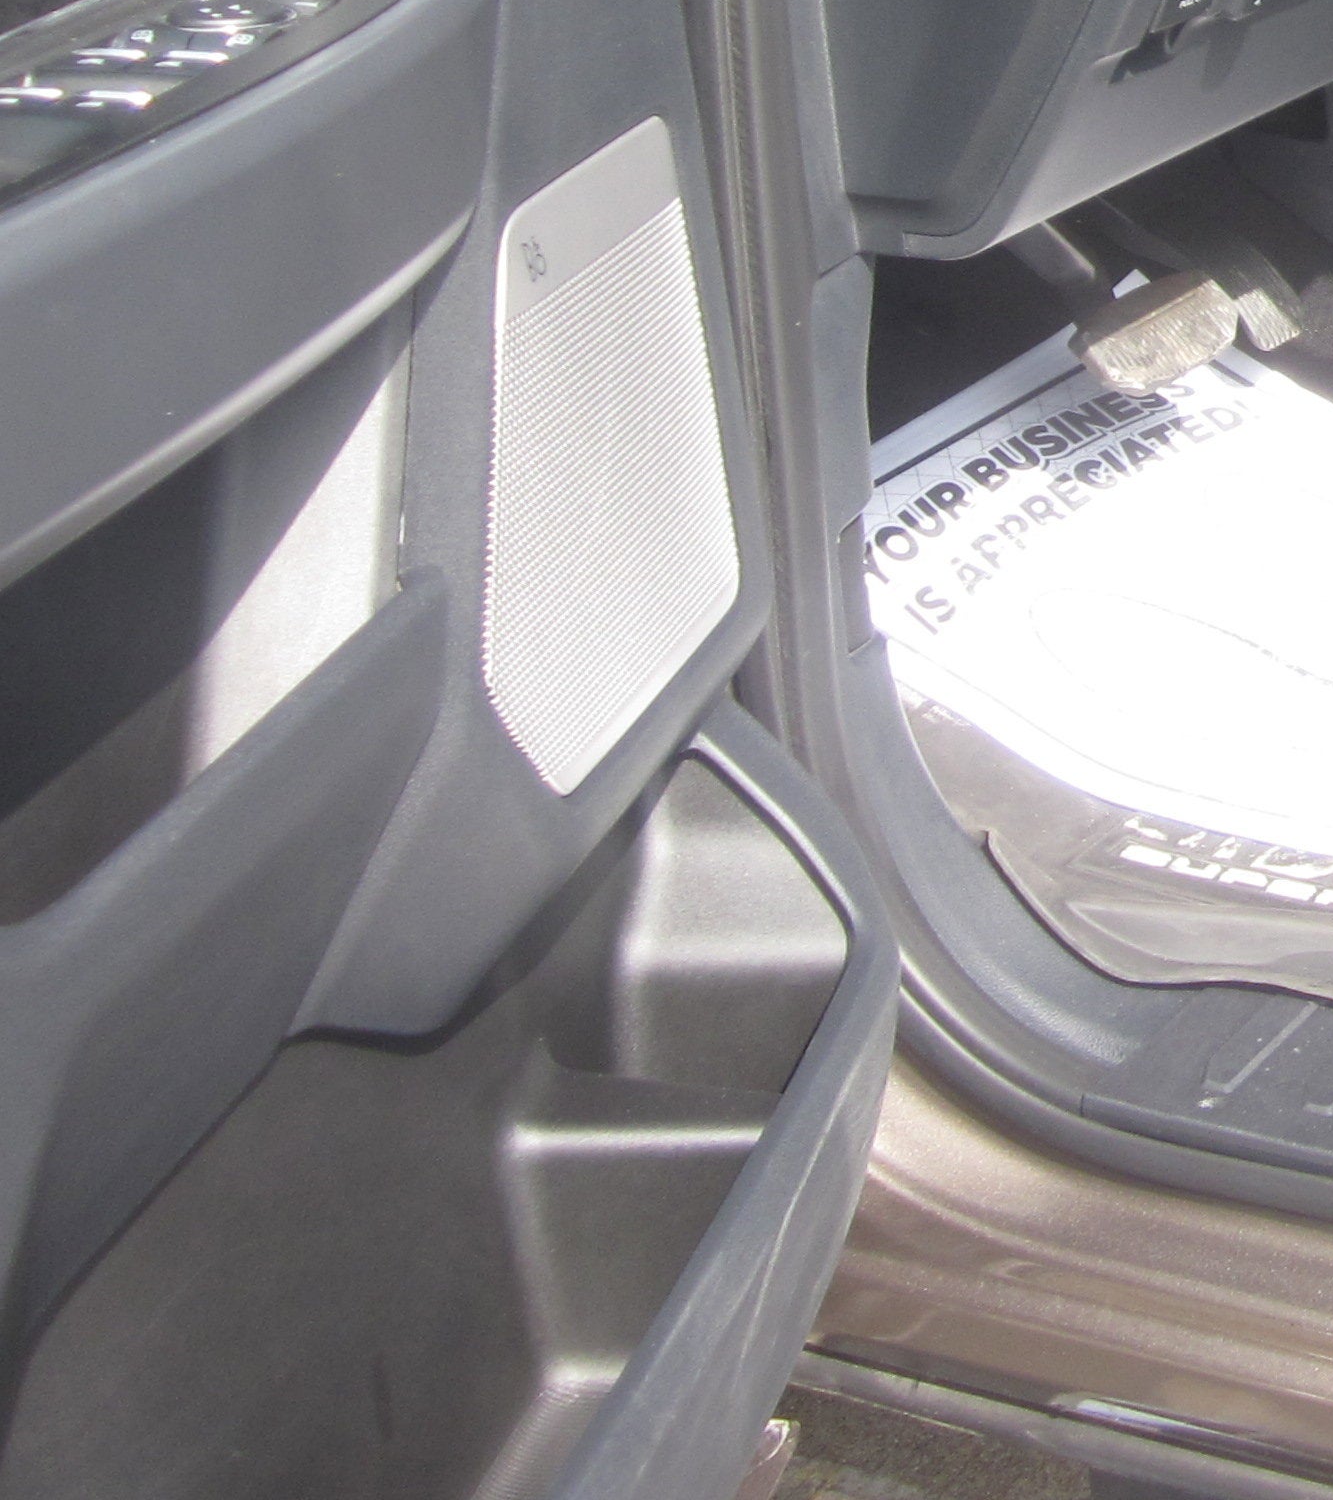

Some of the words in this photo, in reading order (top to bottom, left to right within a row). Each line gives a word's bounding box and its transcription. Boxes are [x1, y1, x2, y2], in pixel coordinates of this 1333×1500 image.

[863, 481, 970, 585] YOUR
[962, 378, 1196, 493] BUSINESS
[904, 585, 956, 636] IS
